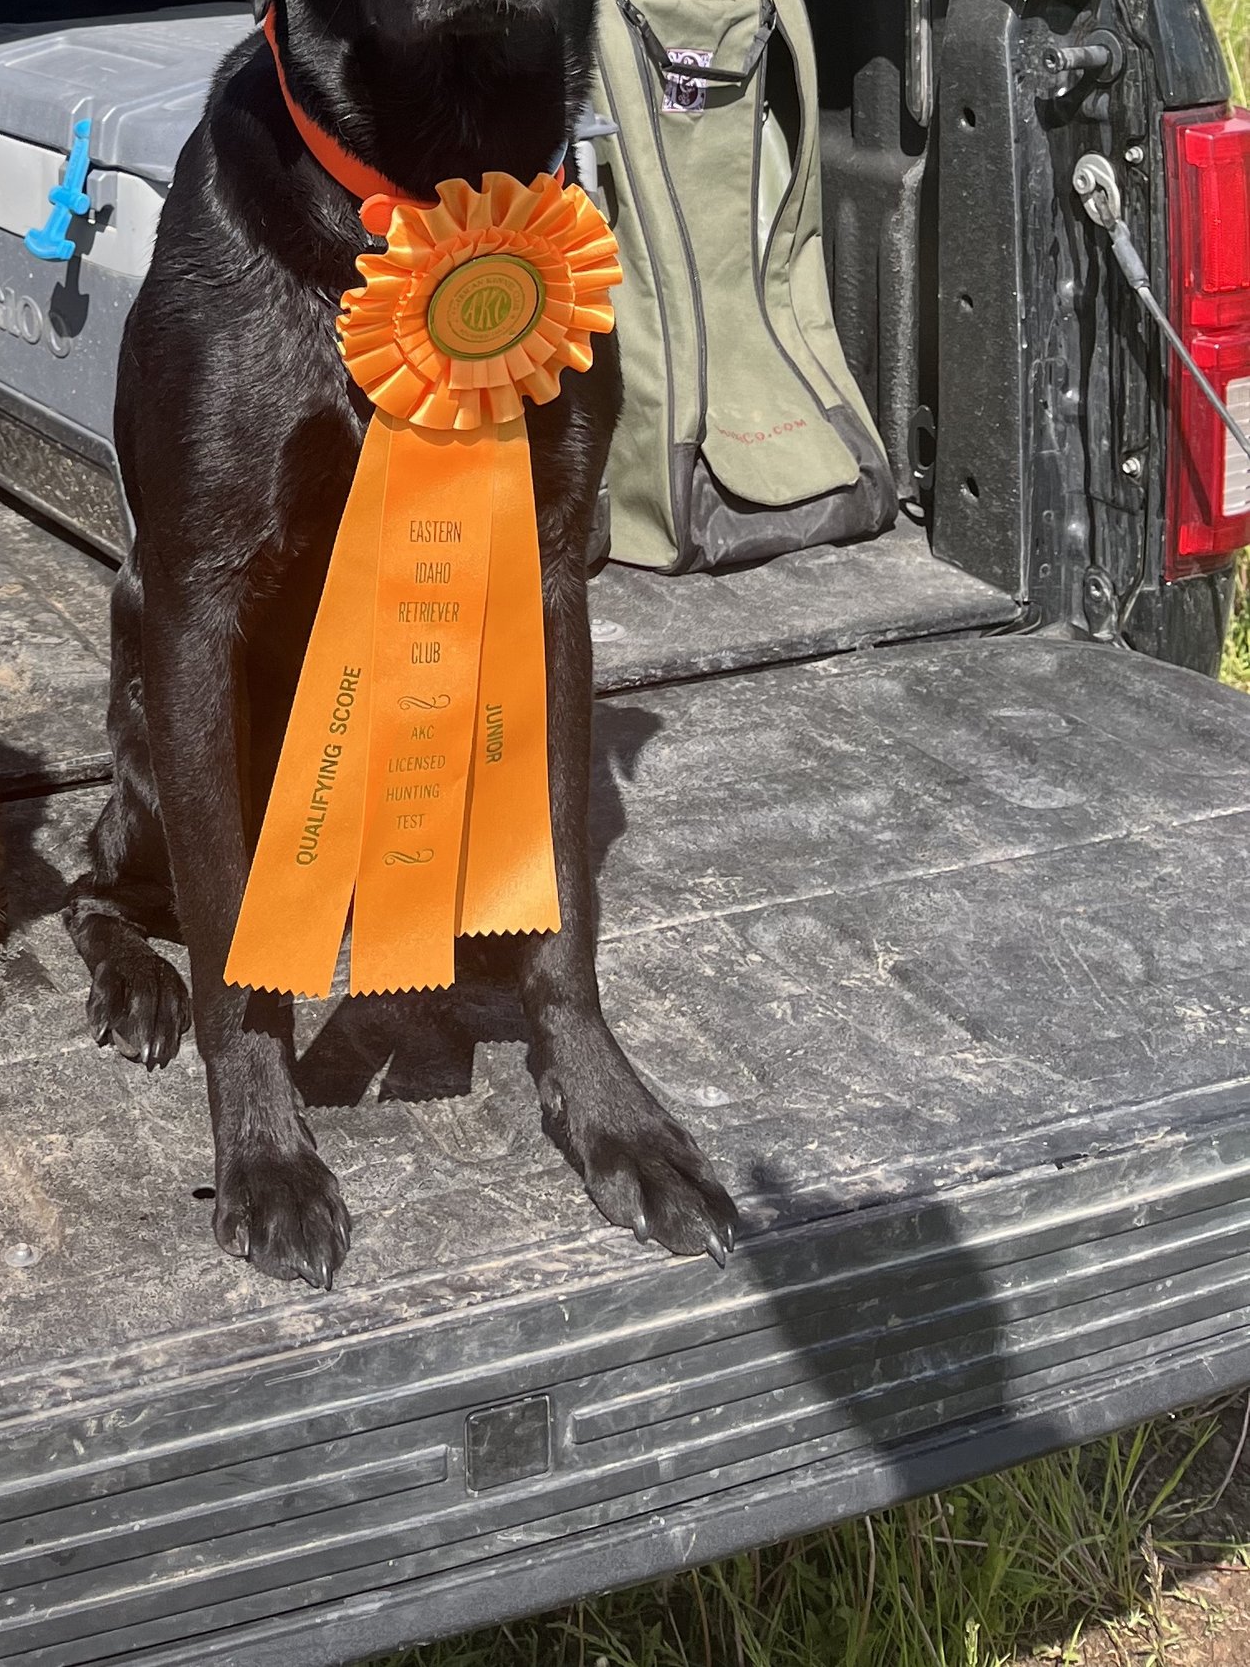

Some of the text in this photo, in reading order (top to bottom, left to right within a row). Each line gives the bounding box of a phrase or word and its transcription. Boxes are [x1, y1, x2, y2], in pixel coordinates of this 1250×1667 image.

[464, 290, 508, 330] AKC
[409, 520, 462, 543] EASTERN
[415, 561, 452, 584] IDAHO
[398, 601, 460, 623] RETRIEVER
[411, 641, 441, 664] CLUB
[411, 725, 435, 740] AKC
[485, 703, 503, 765] JUNIOR
[295, 665, 361, 866] QUALIFYING SCORE
[388, 755, 446, 773] LICENSED
[386, 783, 440, 802] HUNTING
[396, 813, 425, 830] TEST
